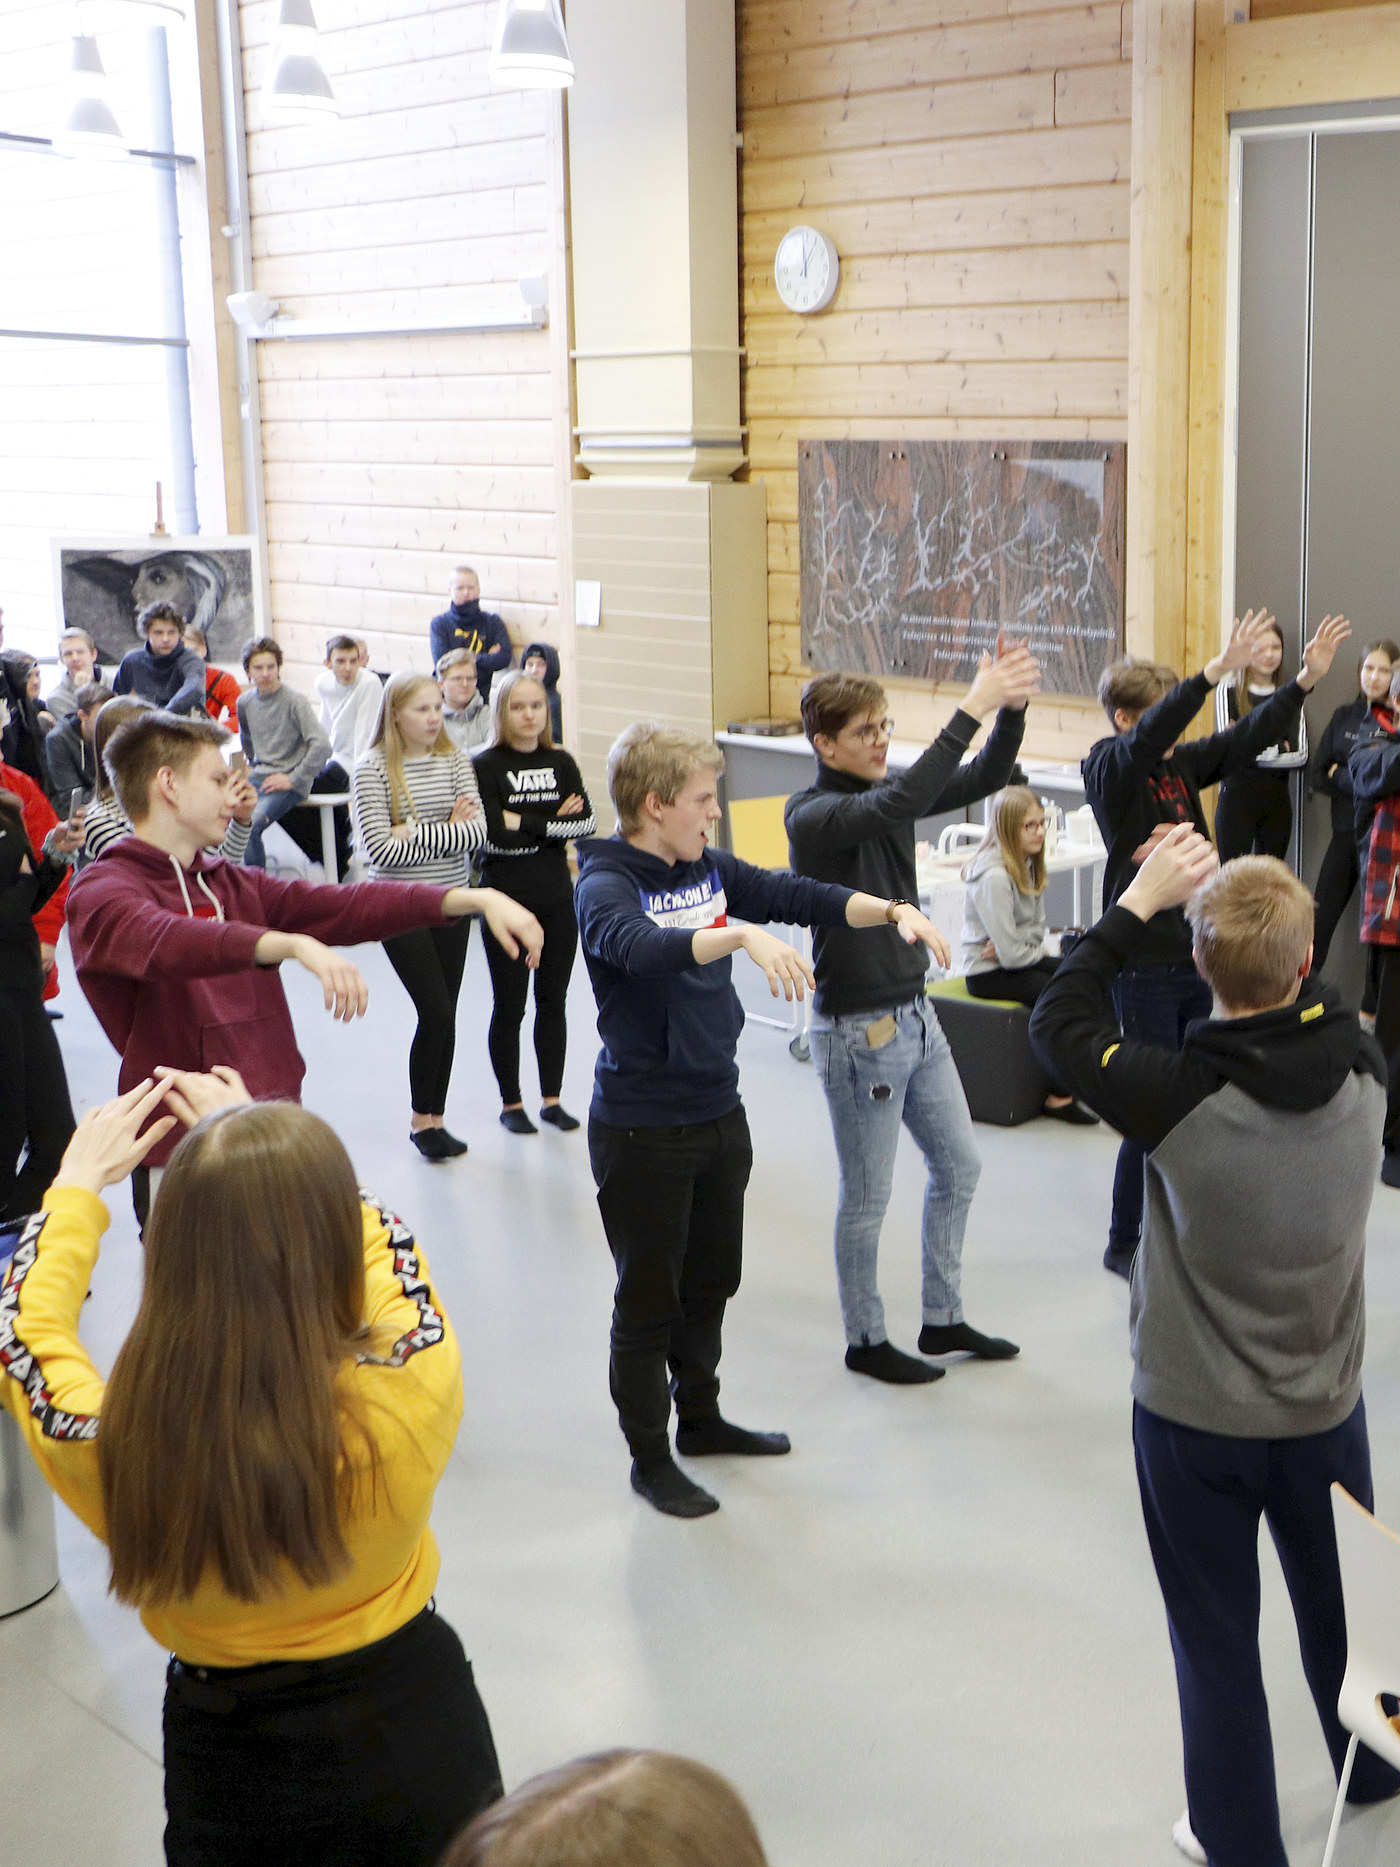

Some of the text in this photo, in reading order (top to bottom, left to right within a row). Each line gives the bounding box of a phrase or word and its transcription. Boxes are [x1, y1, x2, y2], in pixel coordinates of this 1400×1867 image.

[506, 767, 557, 793] VANS
[508, 790, 560, 804] OFF THE WALL
